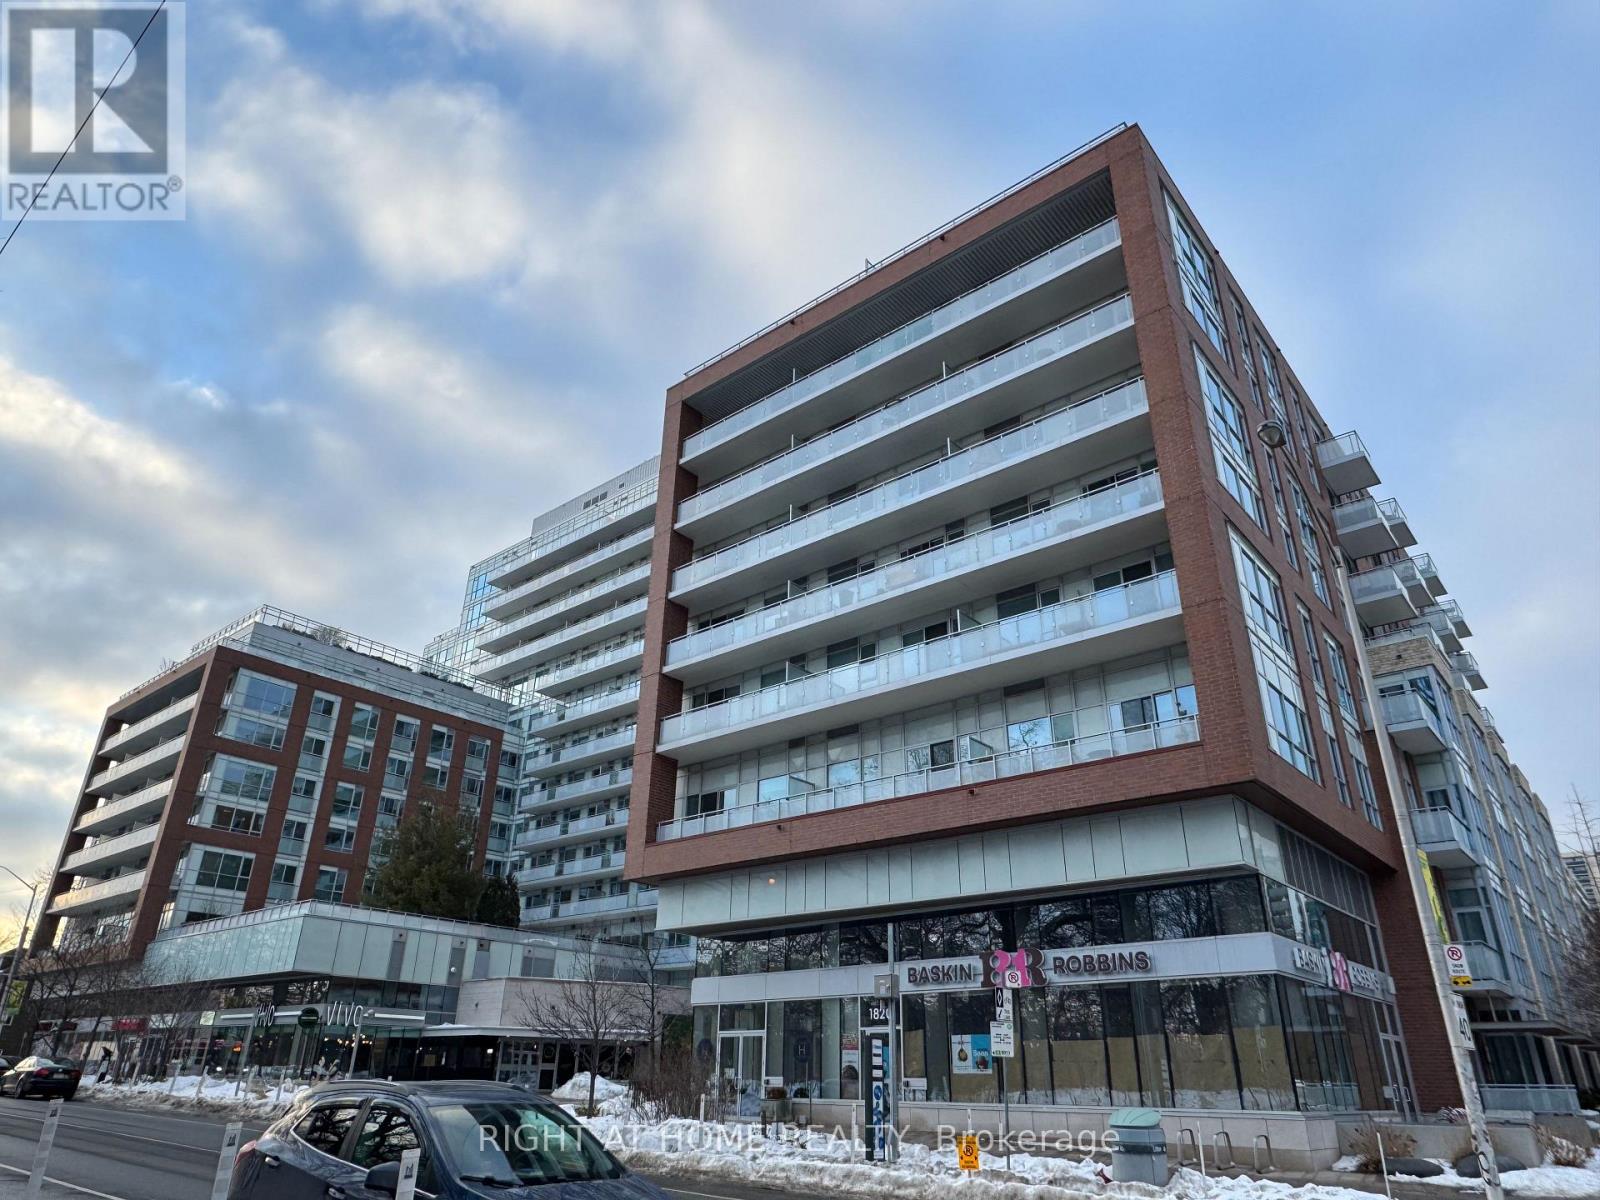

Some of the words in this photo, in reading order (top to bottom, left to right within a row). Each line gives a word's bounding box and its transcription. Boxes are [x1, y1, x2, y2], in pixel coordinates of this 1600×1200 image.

[907, 963, 973, 984] BASKIN
[1053, 951, 1150, 975] ROBBINS
[327, 1001, 364, 1027] VIVO
[1458, 1016, 1472, 1042] 40
